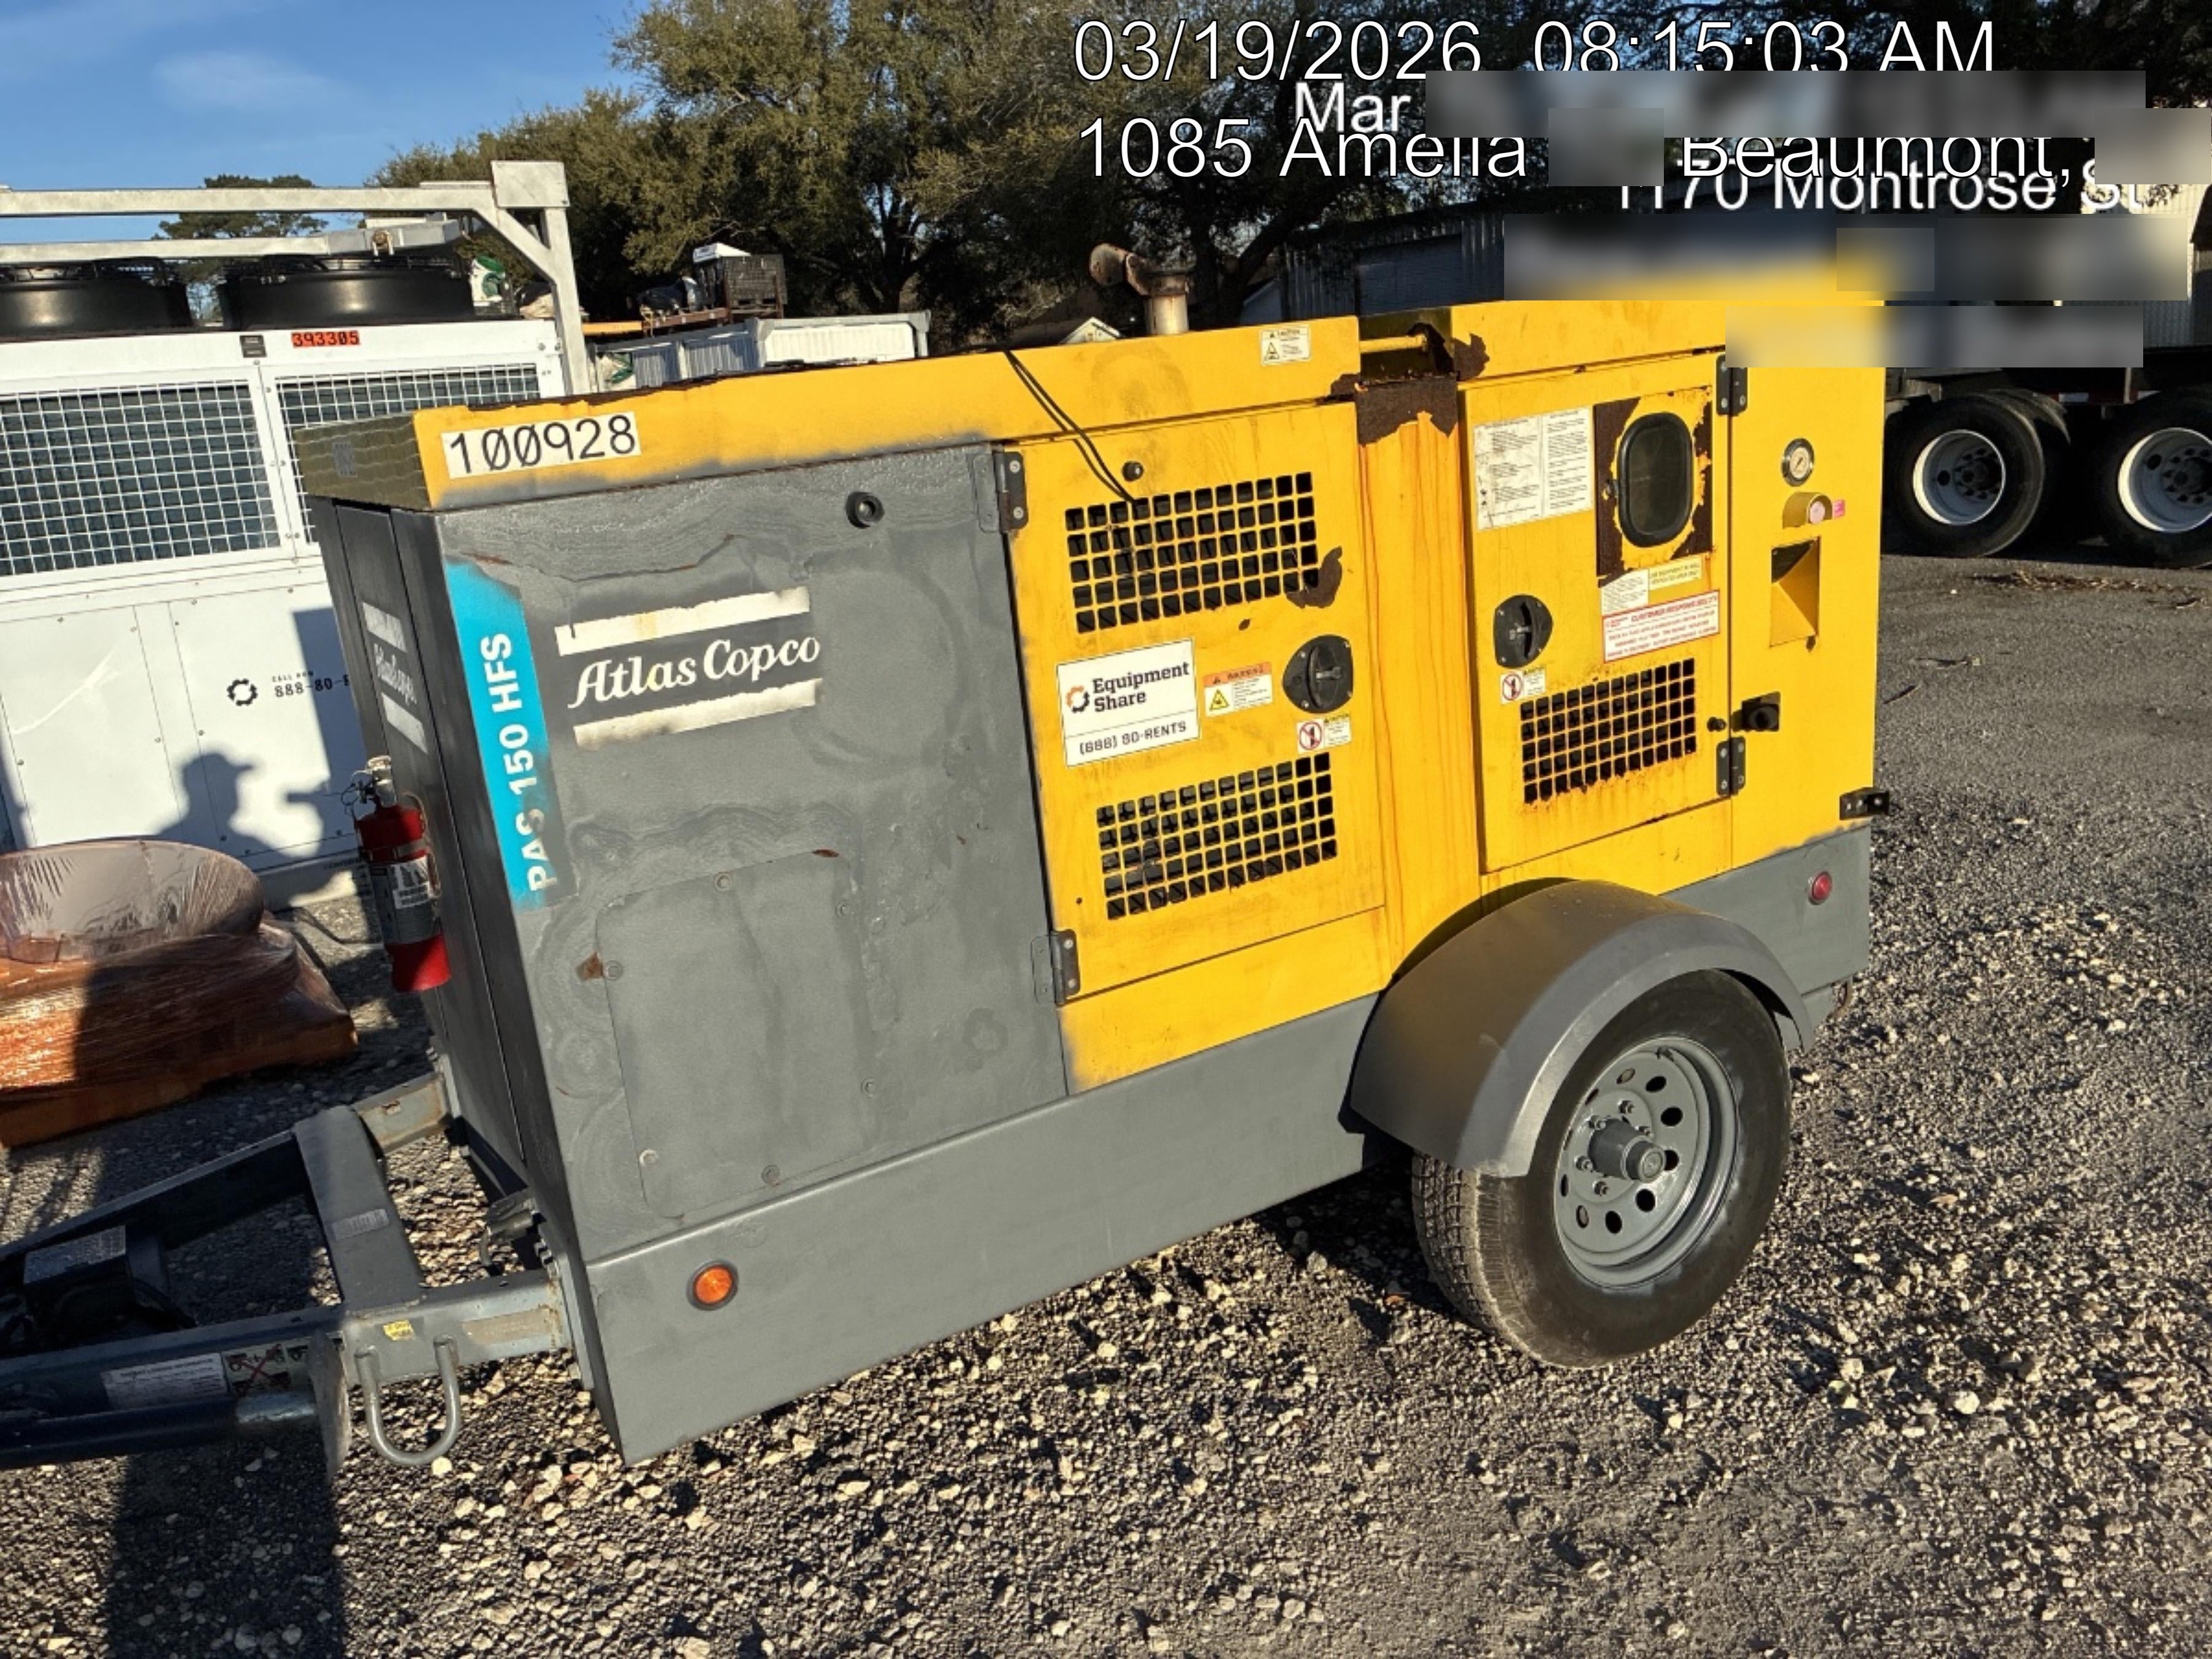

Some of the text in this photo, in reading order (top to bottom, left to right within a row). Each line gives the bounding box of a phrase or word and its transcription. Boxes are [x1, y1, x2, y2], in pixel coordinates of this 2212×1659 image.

[292, 331, 360, 347] 393305
[450, 414, 635, 474] 100928
[480, 633, 524, 713] HFS
[1092, 661, 1190, 694] Equipment
[1094, 691, 1147, 712] Share
[1122, 721, 1186, 745] 80-RENTS
[499, 723, 538, 795] 150
